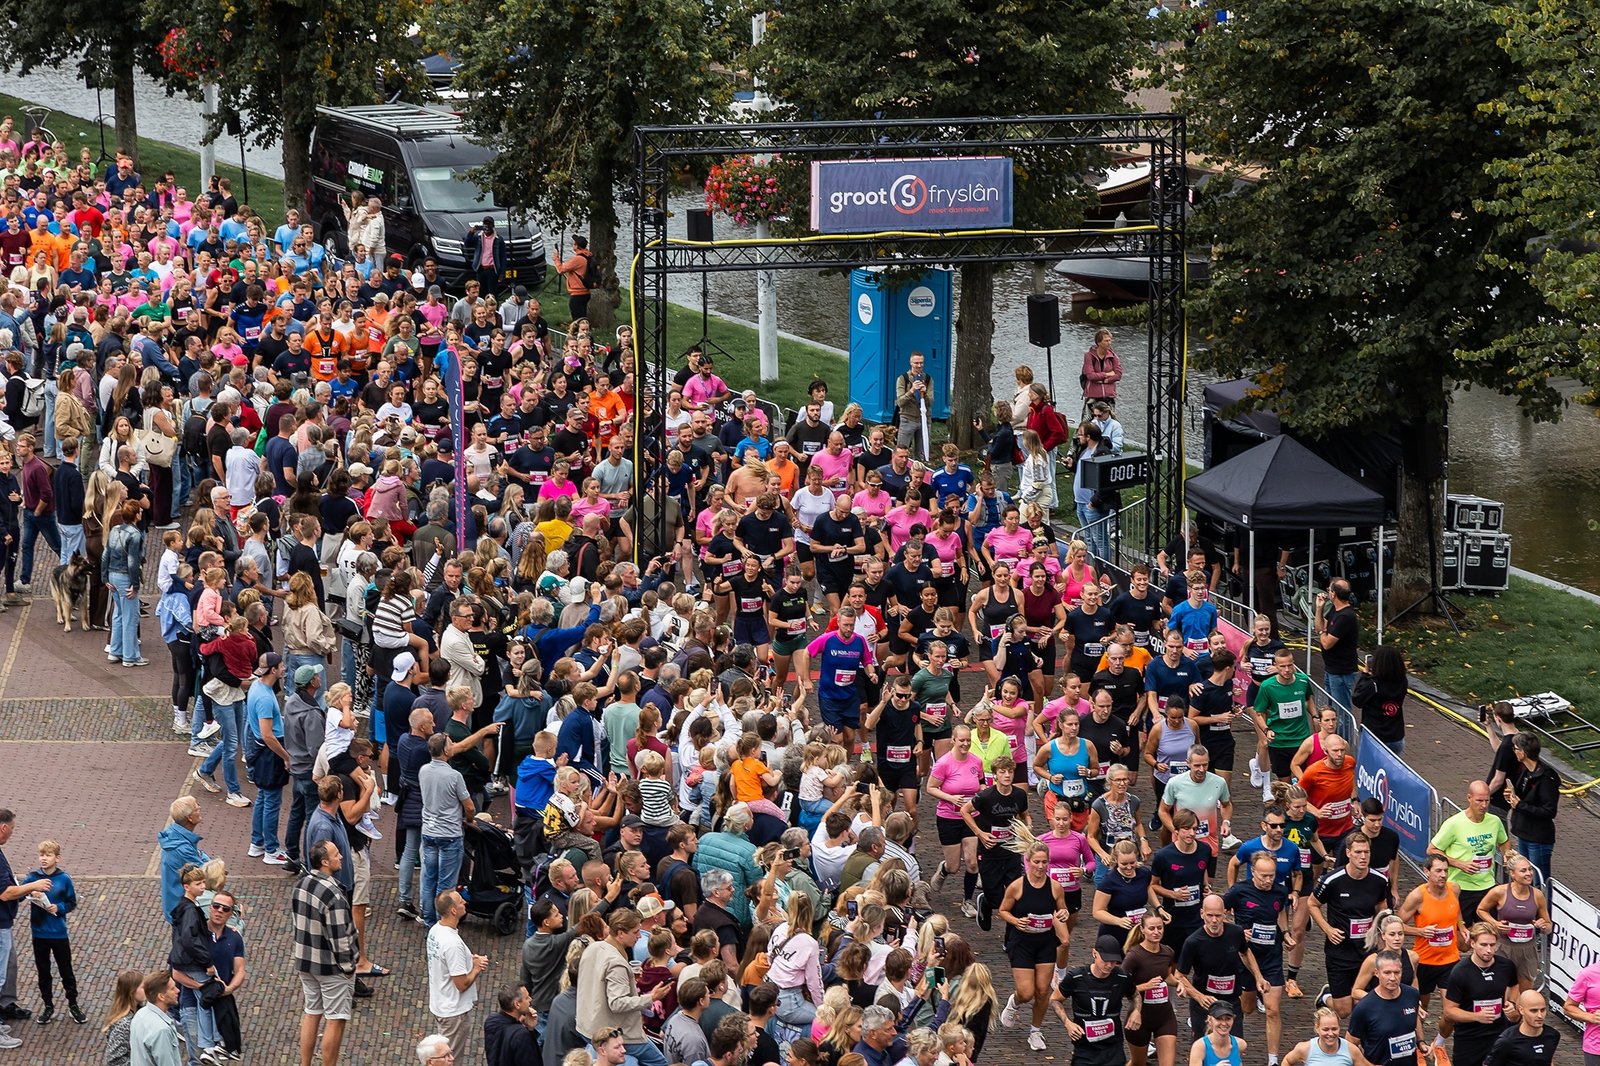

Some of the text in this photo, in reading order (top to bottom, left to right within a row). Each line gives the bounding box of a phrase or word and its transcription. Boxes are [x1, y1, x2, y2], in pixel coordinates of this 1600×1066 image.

[830, 188, 888, 213] groot
[928, 183, 999, 207] fryslân
[1357, 764, 1375, 795] groot
[1388, 789, 1422, 832] fryslân
[1550, 920, 1568, 961] Bij
